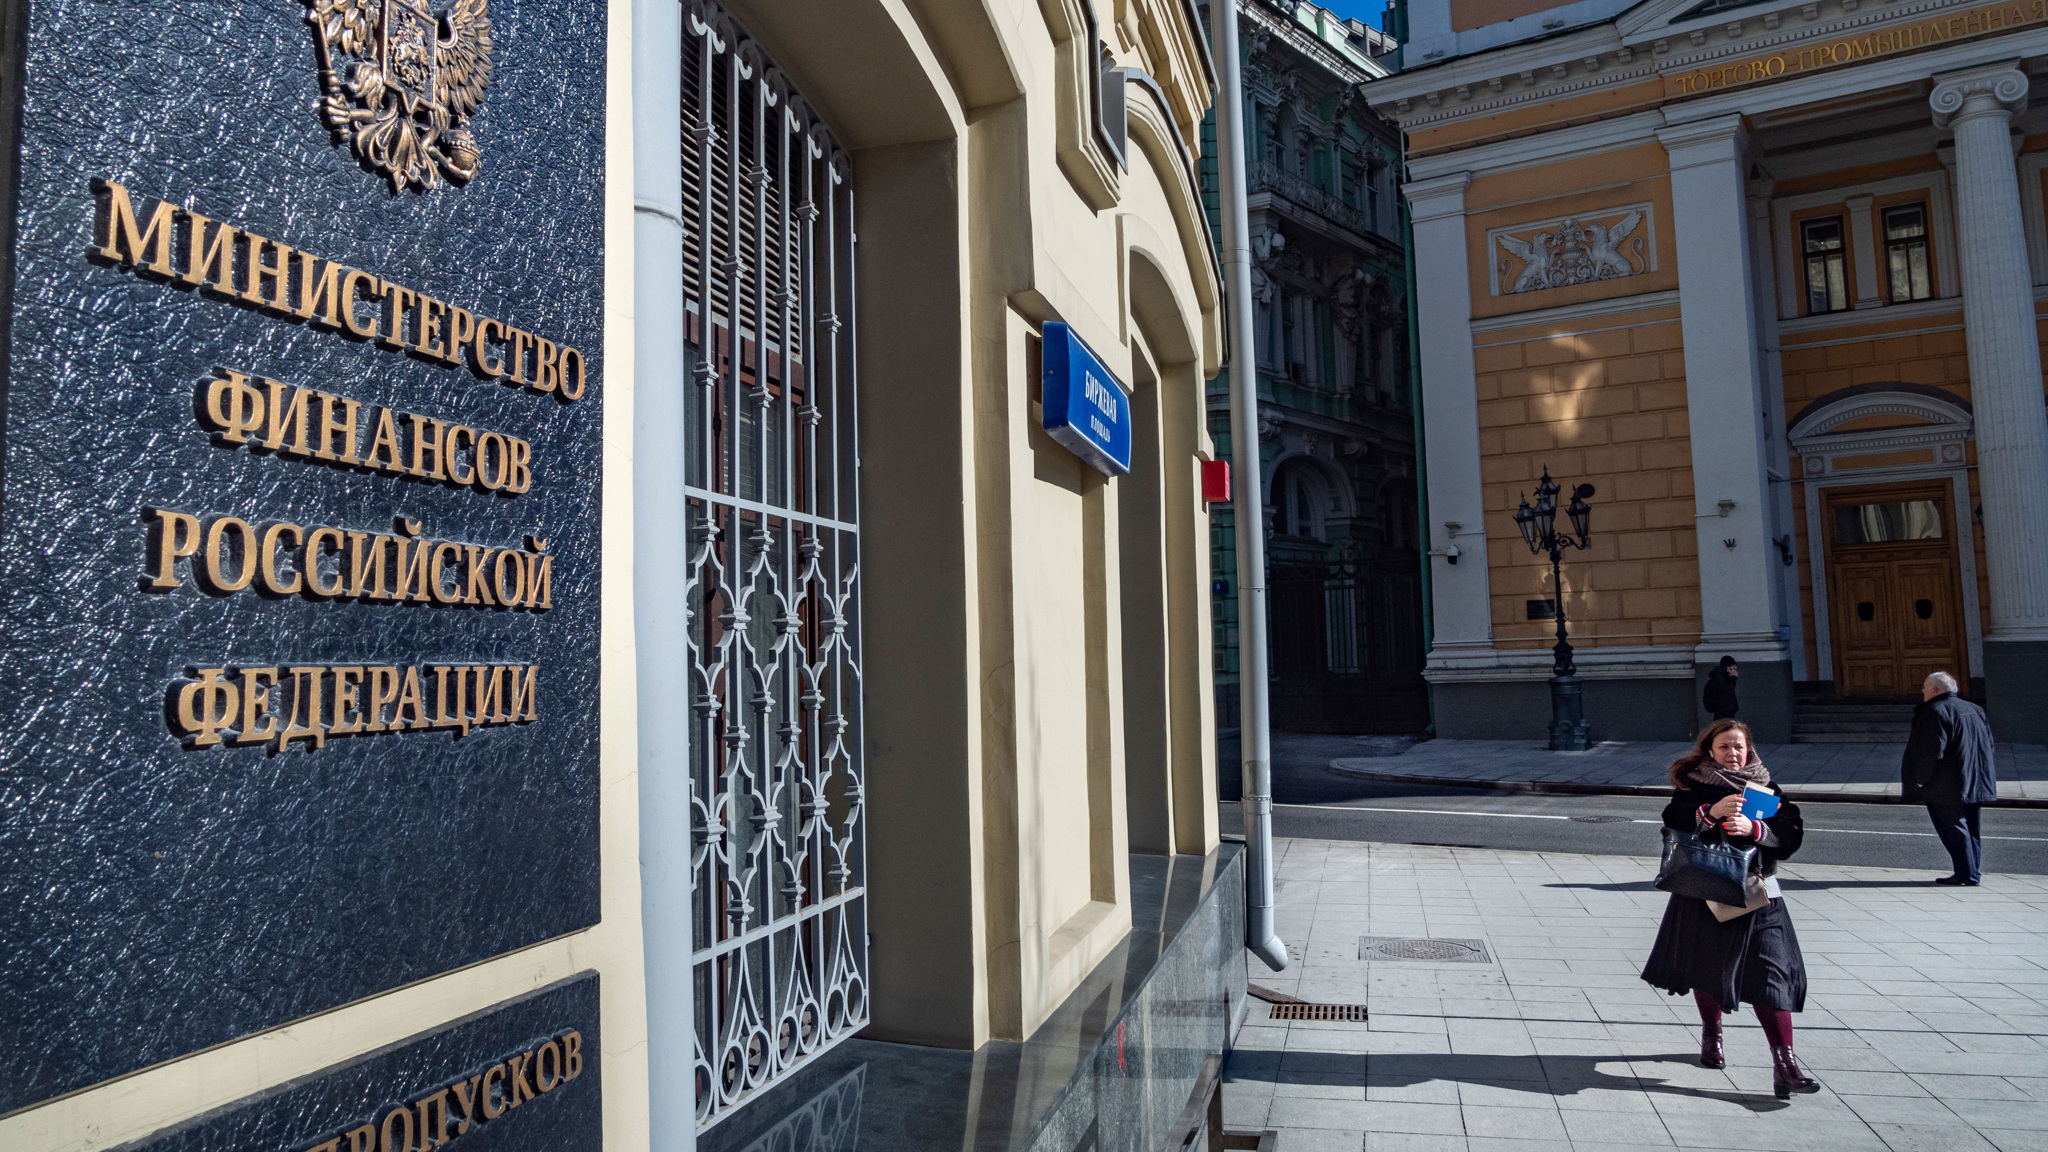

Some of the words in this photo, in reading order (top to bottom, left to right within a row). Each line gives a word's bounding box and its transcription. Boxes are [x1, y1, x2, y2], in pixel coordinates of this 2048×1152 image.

[1676, 1, 2048, 95] ТОРГОВО-ПРОМЫШЛЕННАЯ
[99, 180, 586, 401] МИНИСТЕРСТВО
[206, 368, 532, 495] ФИНАНСОВ
[1085, 369, 1117, 425] БИРЖЕВАЯ
[151, 508, 555, 609] РОССИЙСКОЙ
[177, 665, 538, 752] ФЕДЕРАЦИИ
